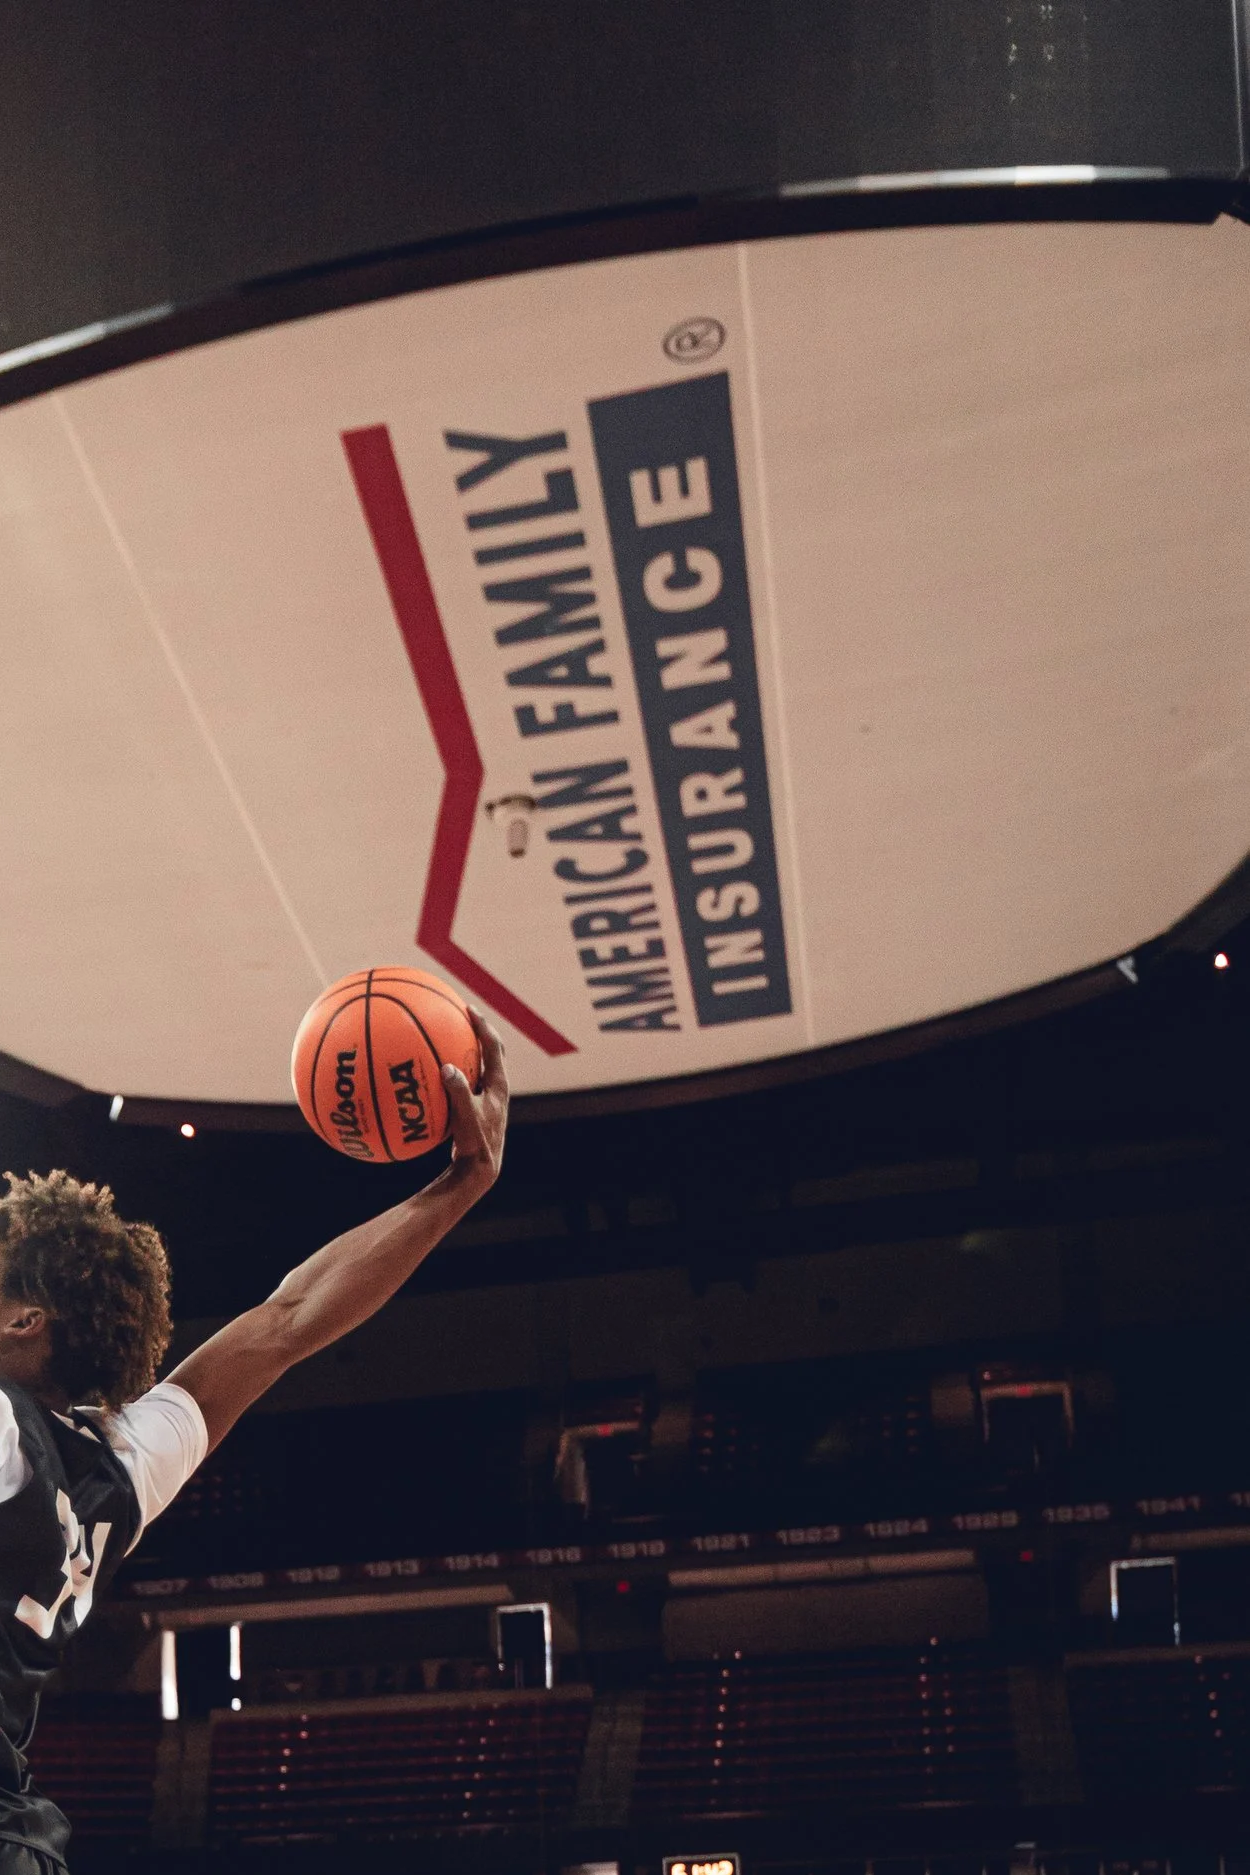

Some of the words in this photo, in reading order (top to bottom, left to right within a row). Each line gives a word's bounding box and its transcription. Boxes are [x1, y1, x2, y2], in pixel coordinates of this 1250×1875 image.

[443, 428, 621, 738] FAMILY
[629, 454, 770, 996] INSURANCE
[533, 758, 682, 1034] AMERICAN
[329, 1048, 375, 1158] Wilson
[389, 1059, 429, 1144] NCAA
